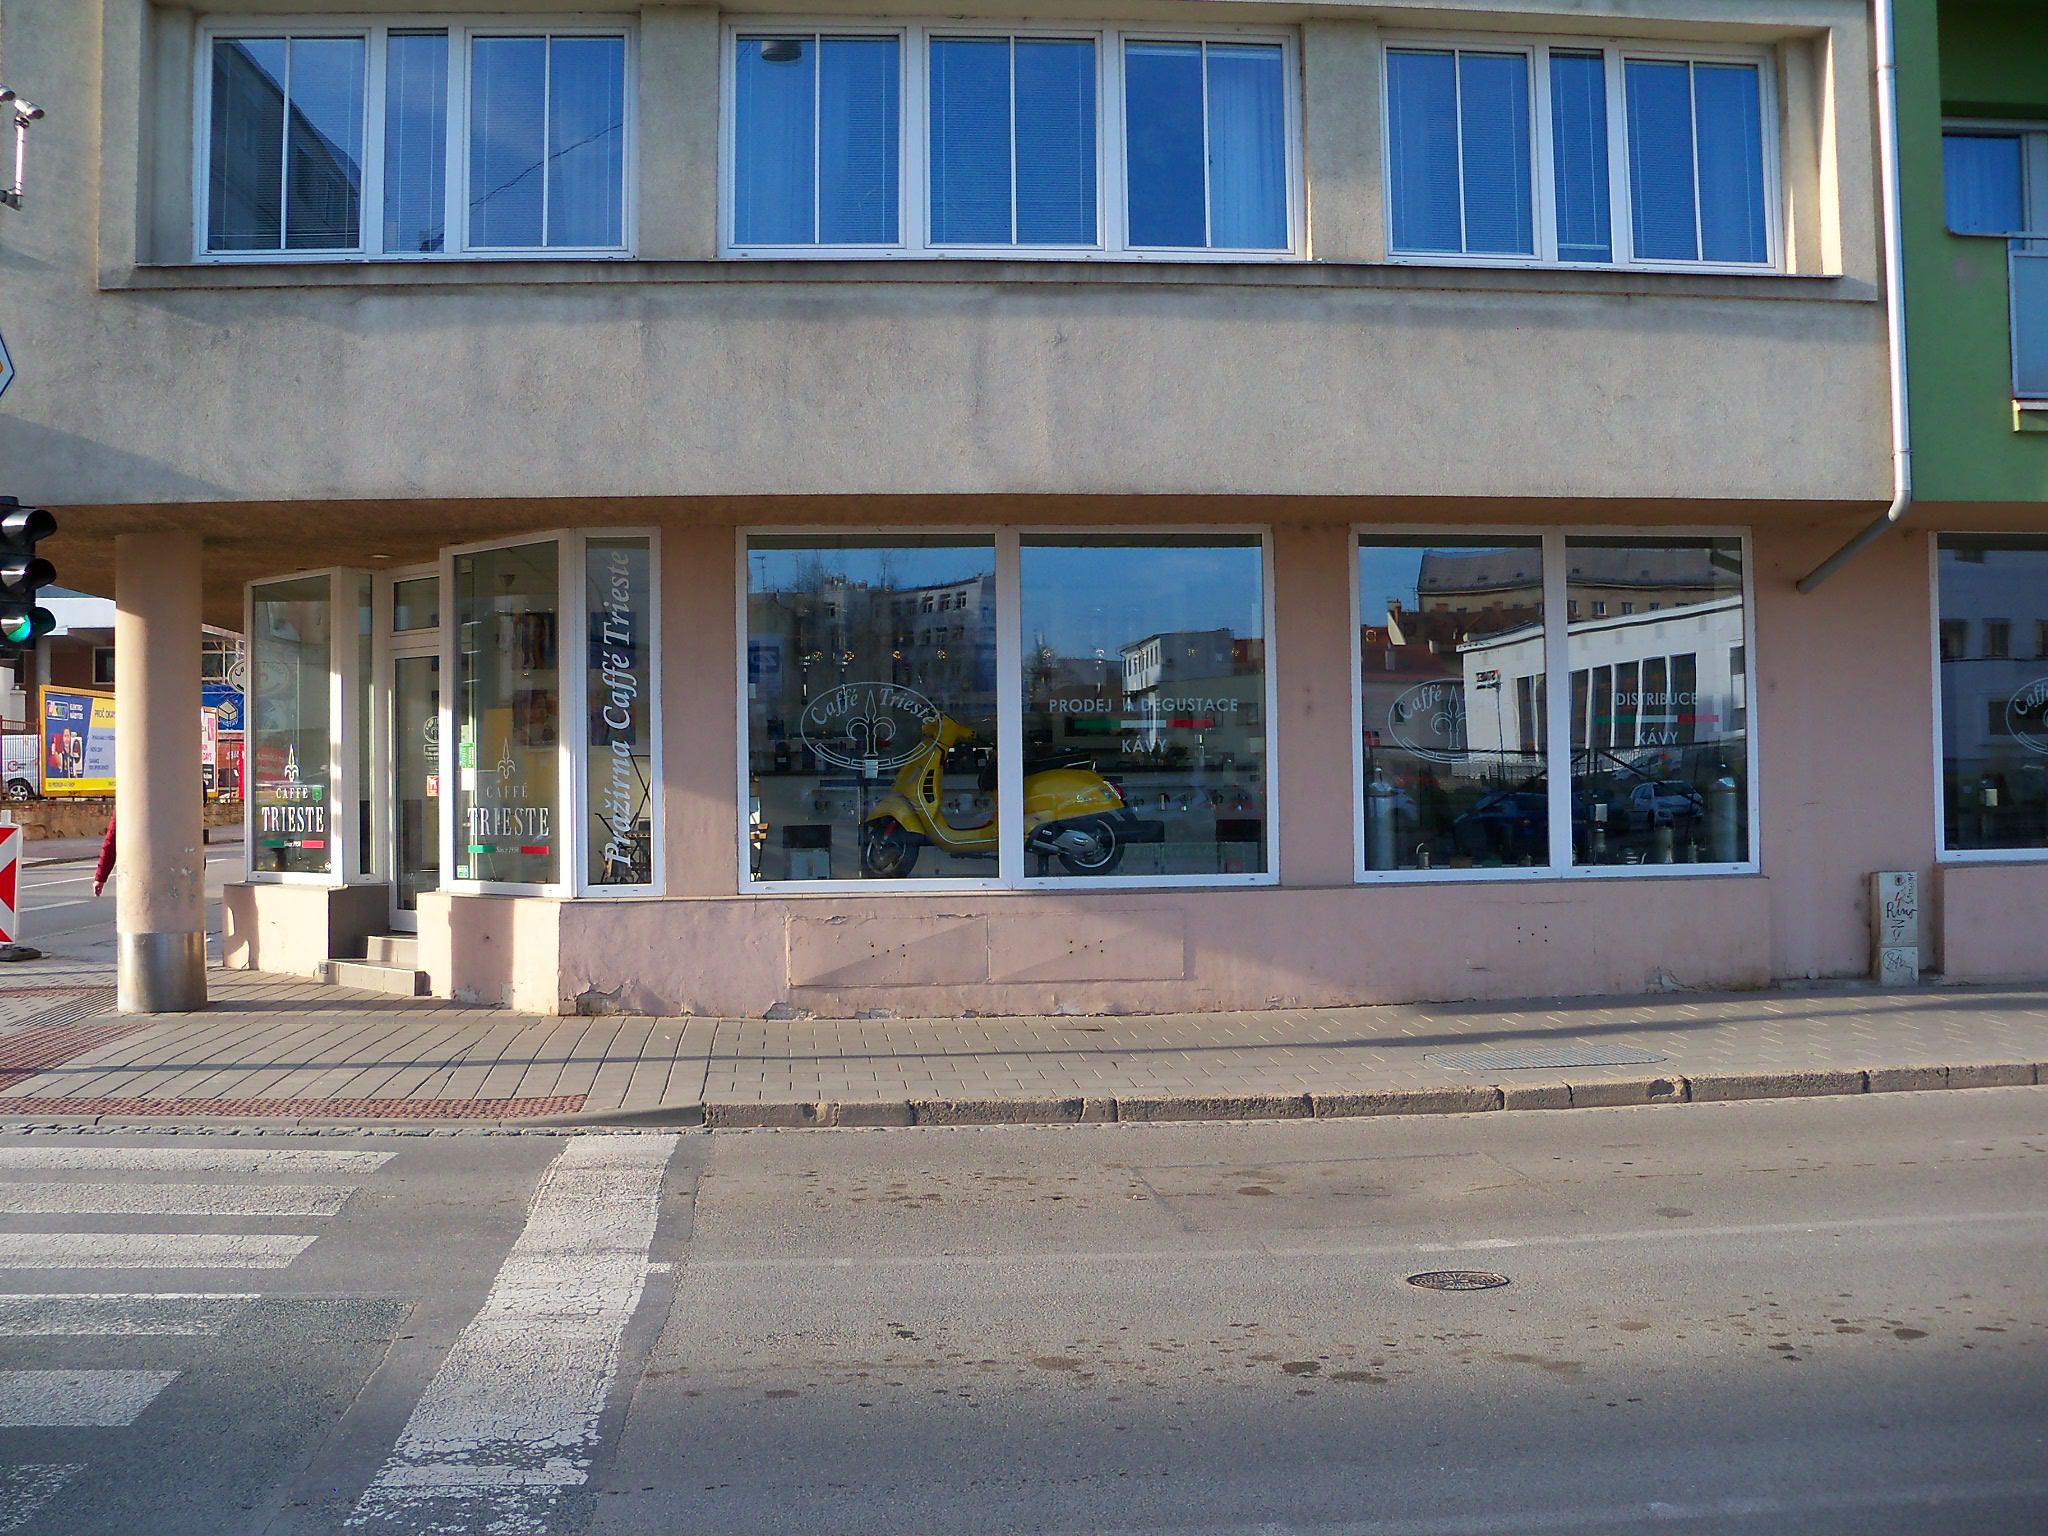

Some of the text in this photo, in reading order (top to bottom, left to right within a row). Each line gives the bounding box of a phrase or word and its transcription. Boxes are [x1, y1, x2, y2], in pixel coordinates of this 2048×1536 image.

[602, 551, 638, 869] Pražírna Caffé Trieste
[811, 687, 937, 726] Caffé Trieste
[1049, 699, 1112, 713] PRODEJ
[1141, 698, 1239, 713] DEGUSTACE
[1399, 684, 1443, 721] Caffé
[2014, 682, 2048, 716] Caff
[1121, 734, 1168, 753] KÁVY
[1639, 727, 1679, 745] KÁVY
[275, 784, 309, 799] CAFFÉ
[486, 782, 528, 798] CAFFÉ
[261, 806, 325, 833] TRIESTE
[467, 807, 550, 837] TRIESTE
